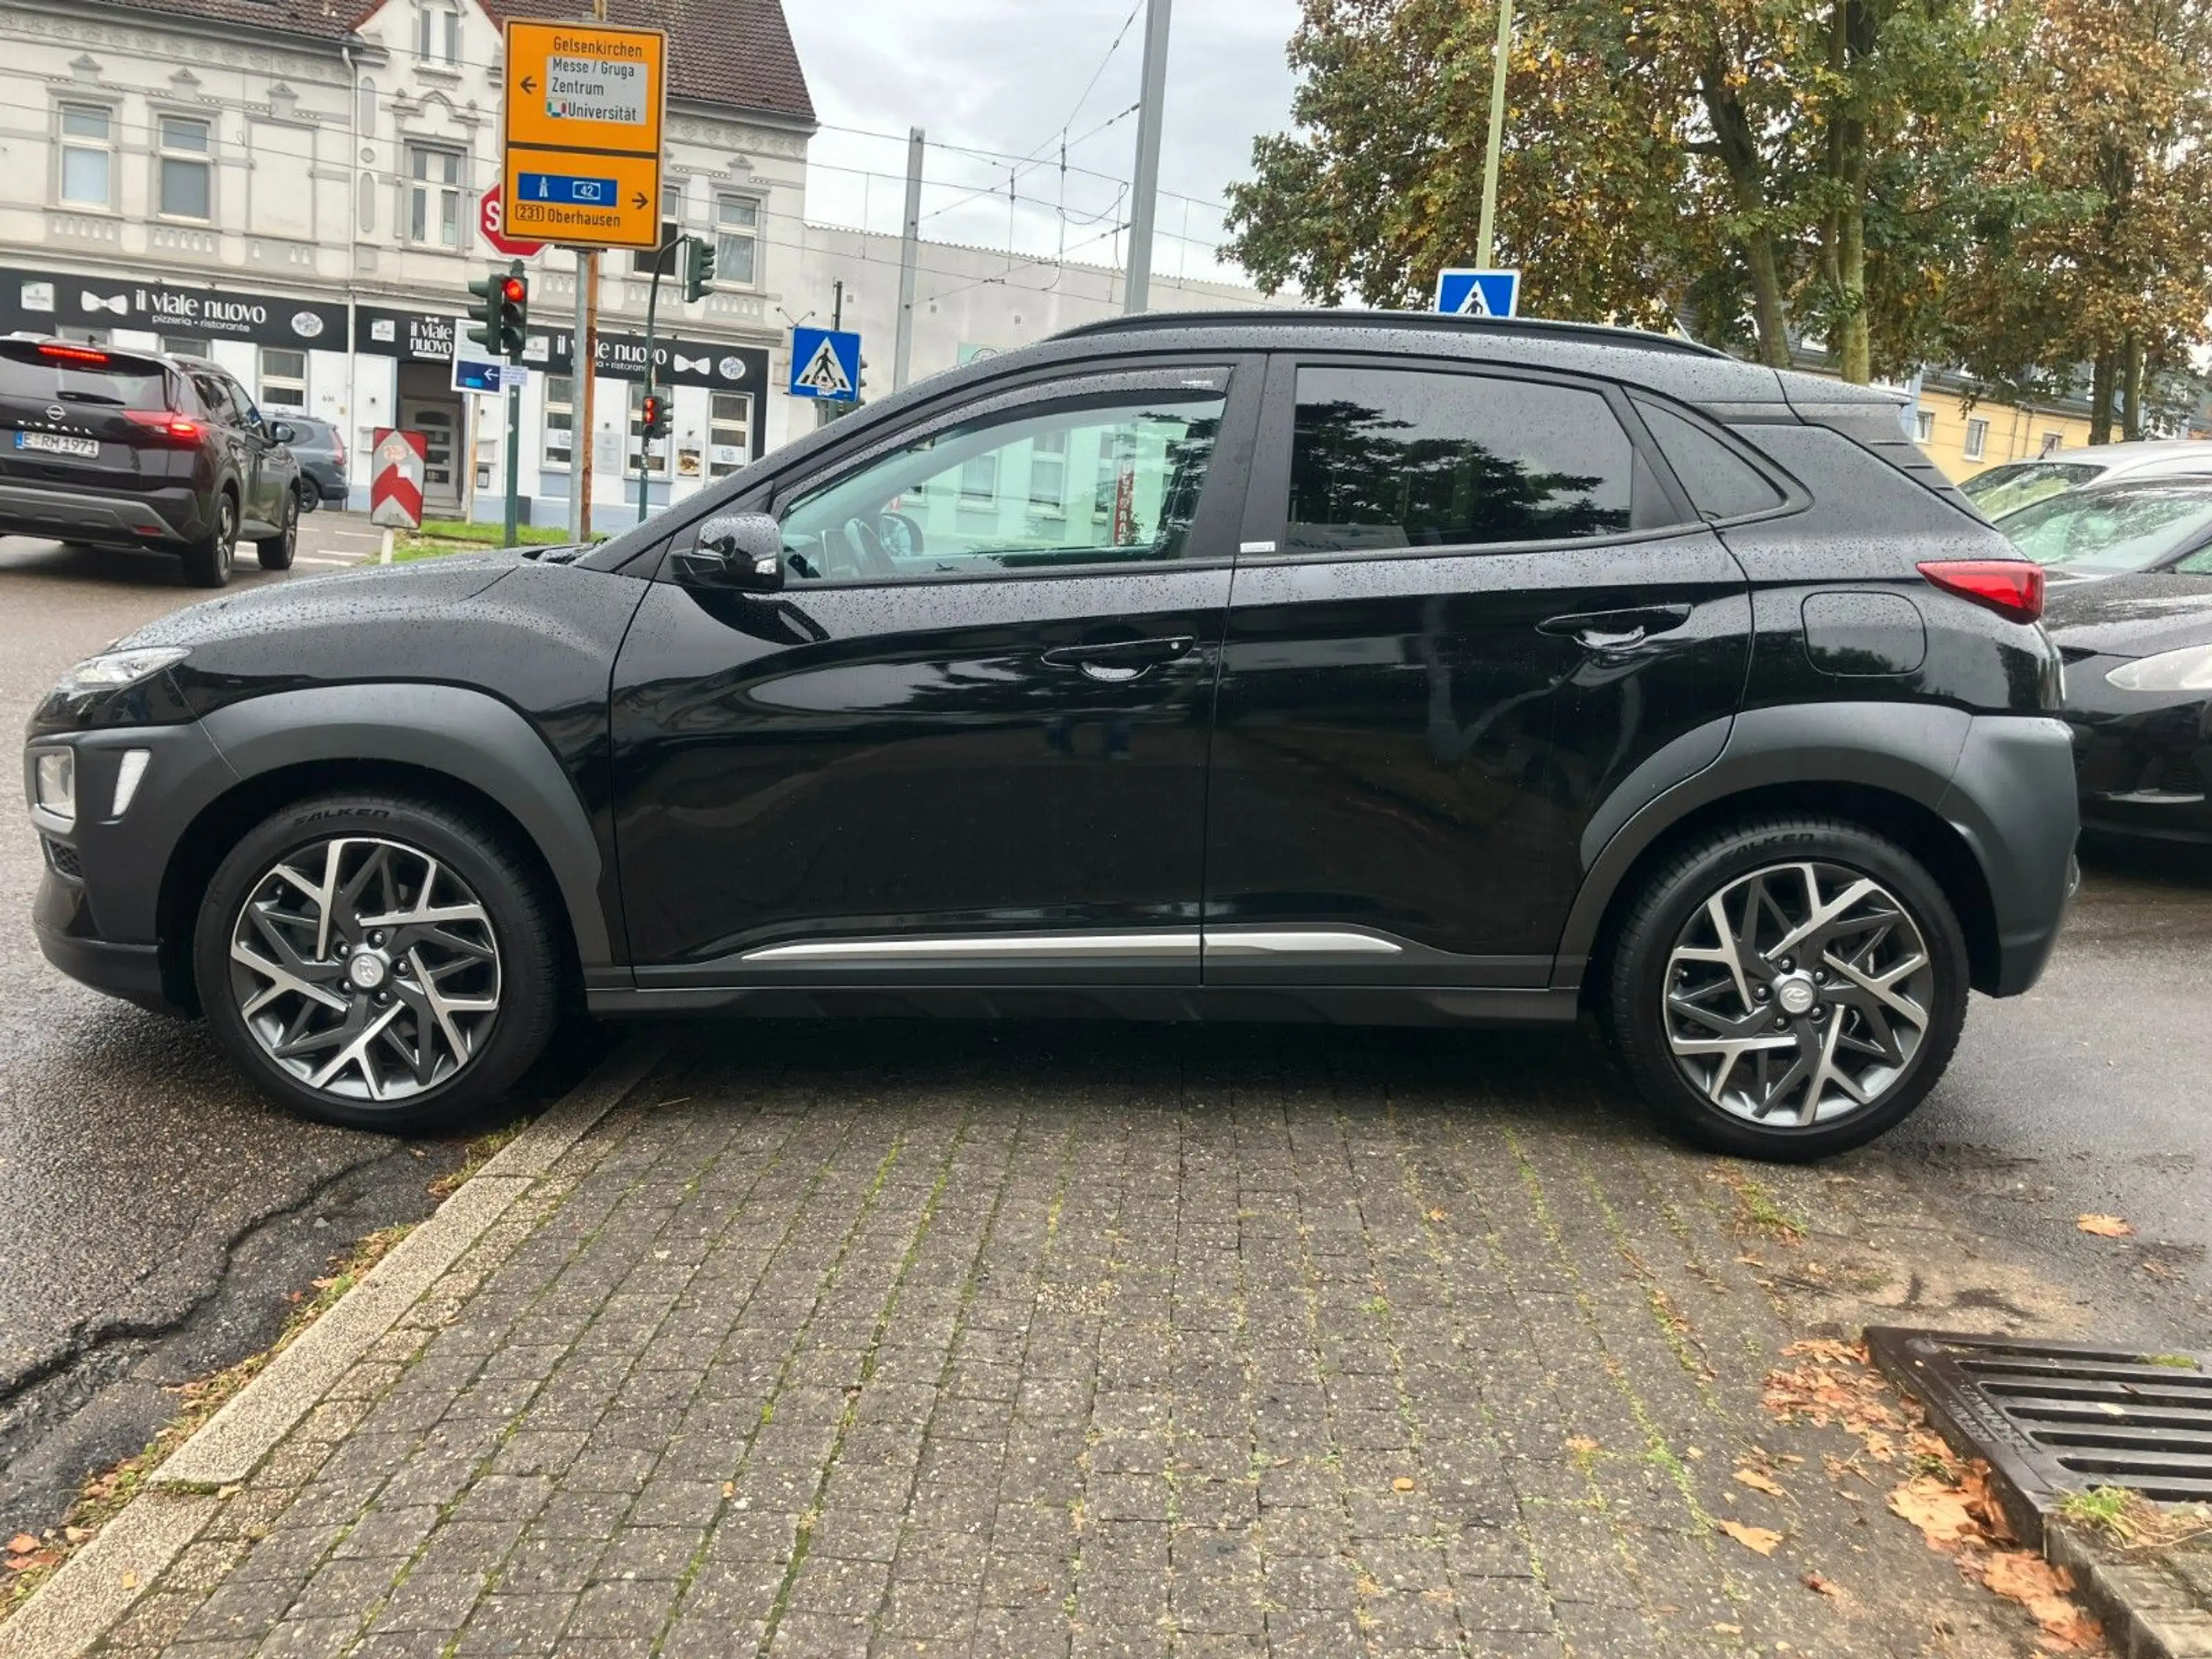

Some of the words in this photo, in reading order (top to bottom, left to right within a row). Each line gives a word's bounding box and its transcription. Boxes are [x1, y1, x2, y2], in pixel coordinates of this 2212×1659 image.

[554, 36, 642, 58] Gelsenkirchen
[553, 57, 589, 73] Messe
[601, 61, 635, 79] Gruga
[552, 77, 604, 96] Zentrum
[580, 185, 594, 197] 42
[520, 206, 540, 220] 231
[548, 208, 620, 228] Oberhausen
[151, 292, 199, 317] viale
[204, 301, 266, 324] nuovo
[200, 320, 250, 332] ristorante
[410, 338, 453, 354] nuovo
[294, 808, 391, 827] FALKEN
